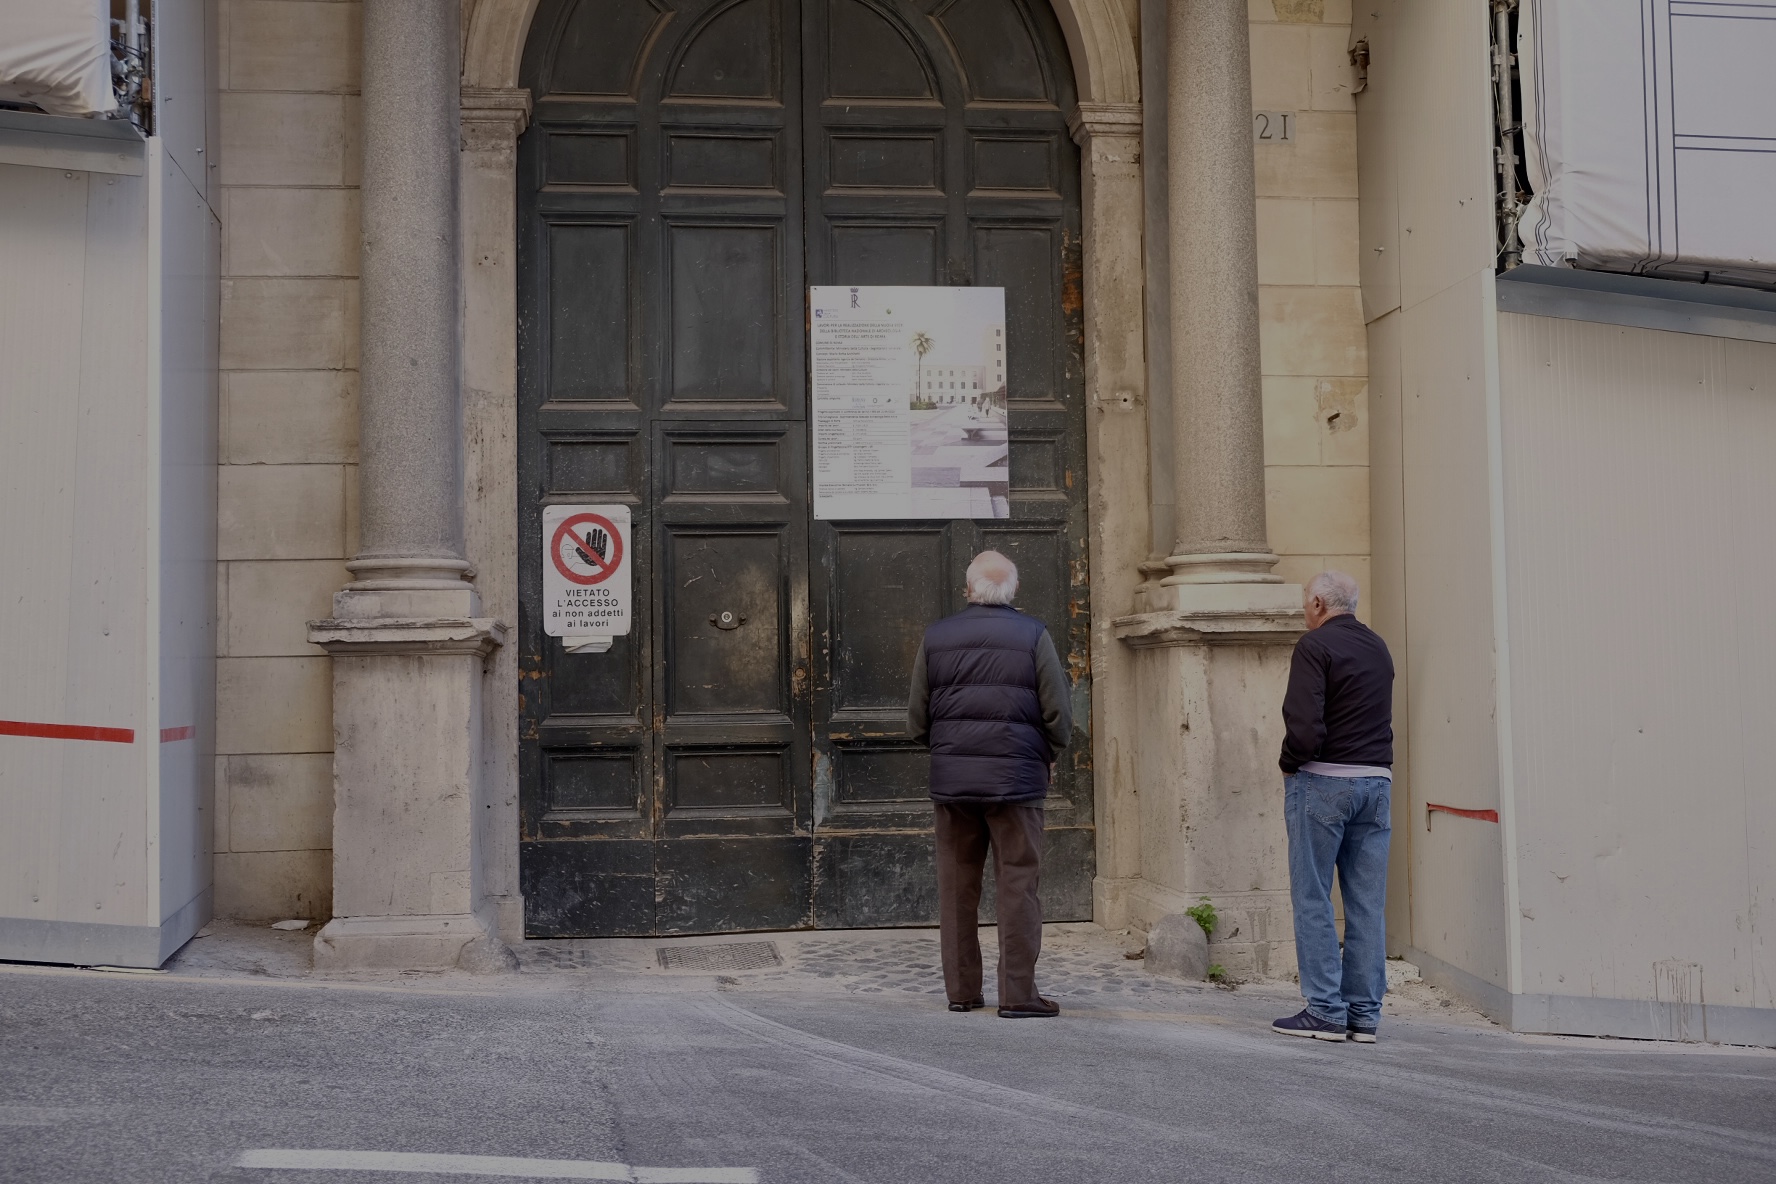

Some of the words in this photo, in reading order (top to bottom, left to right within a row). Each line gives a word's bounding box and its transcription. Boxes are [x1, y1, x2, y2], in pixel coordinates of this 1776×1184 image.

[1255, 113, 1289, 140] 21
[565, 588, 610, 597] VIETATO
[557, 598, 619, 607] L'ACCESSO
[552, 610, 561, 618] ai
[587, 609, 624, 617] addetti
[579, 619, 609, 627] lavori
